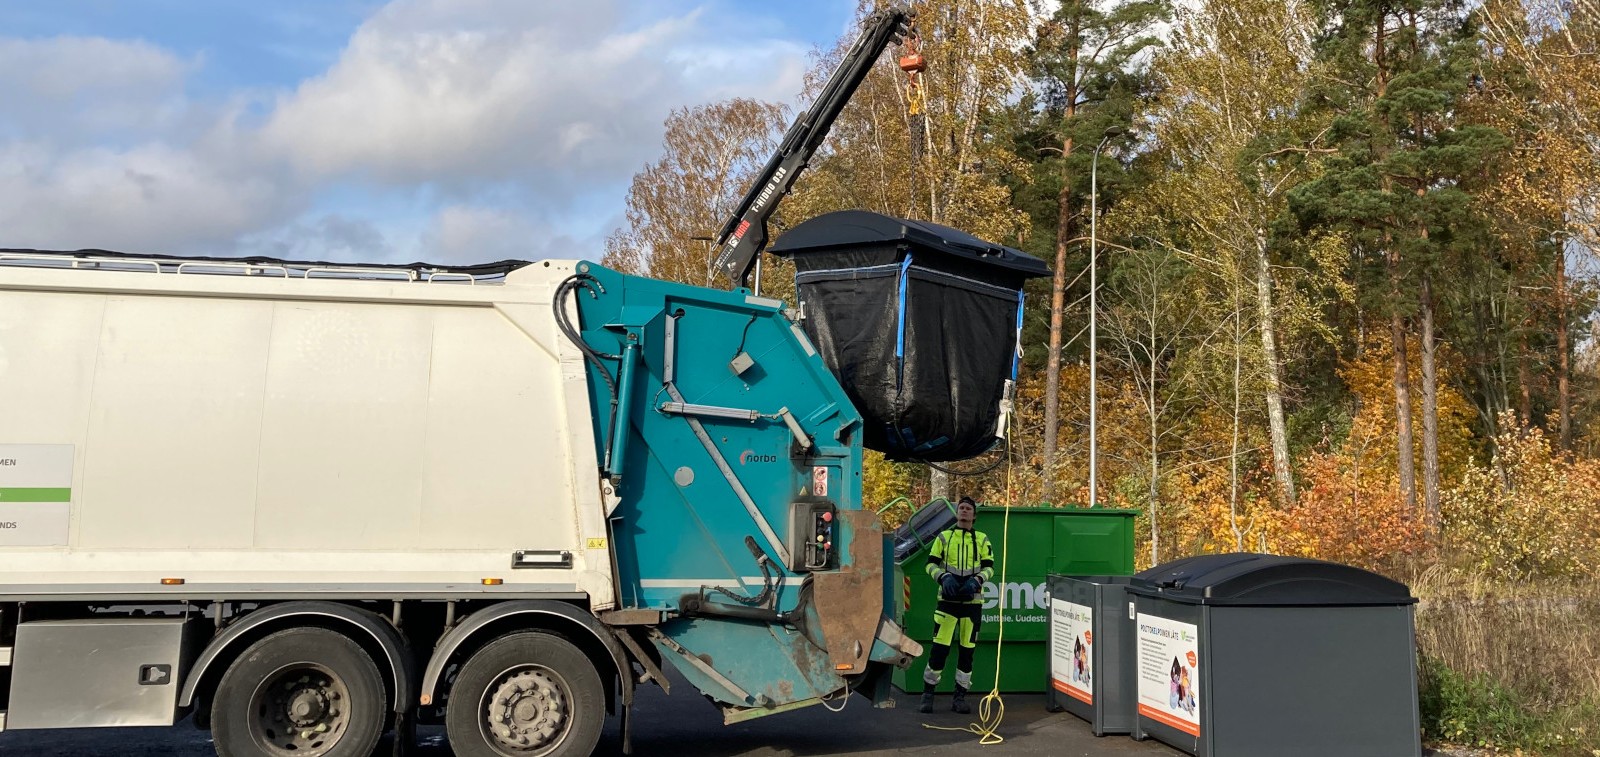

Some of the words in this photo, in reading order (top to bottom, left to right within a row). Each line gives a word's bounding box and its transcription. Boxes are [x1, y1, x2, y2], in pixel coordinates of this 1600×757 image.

[751, 182, 776, 213] T-HIDUO
[772, 166, 787, 184] 038
[746, 454, 777, 463] norba
[0, 521, 17, 529] NDS
